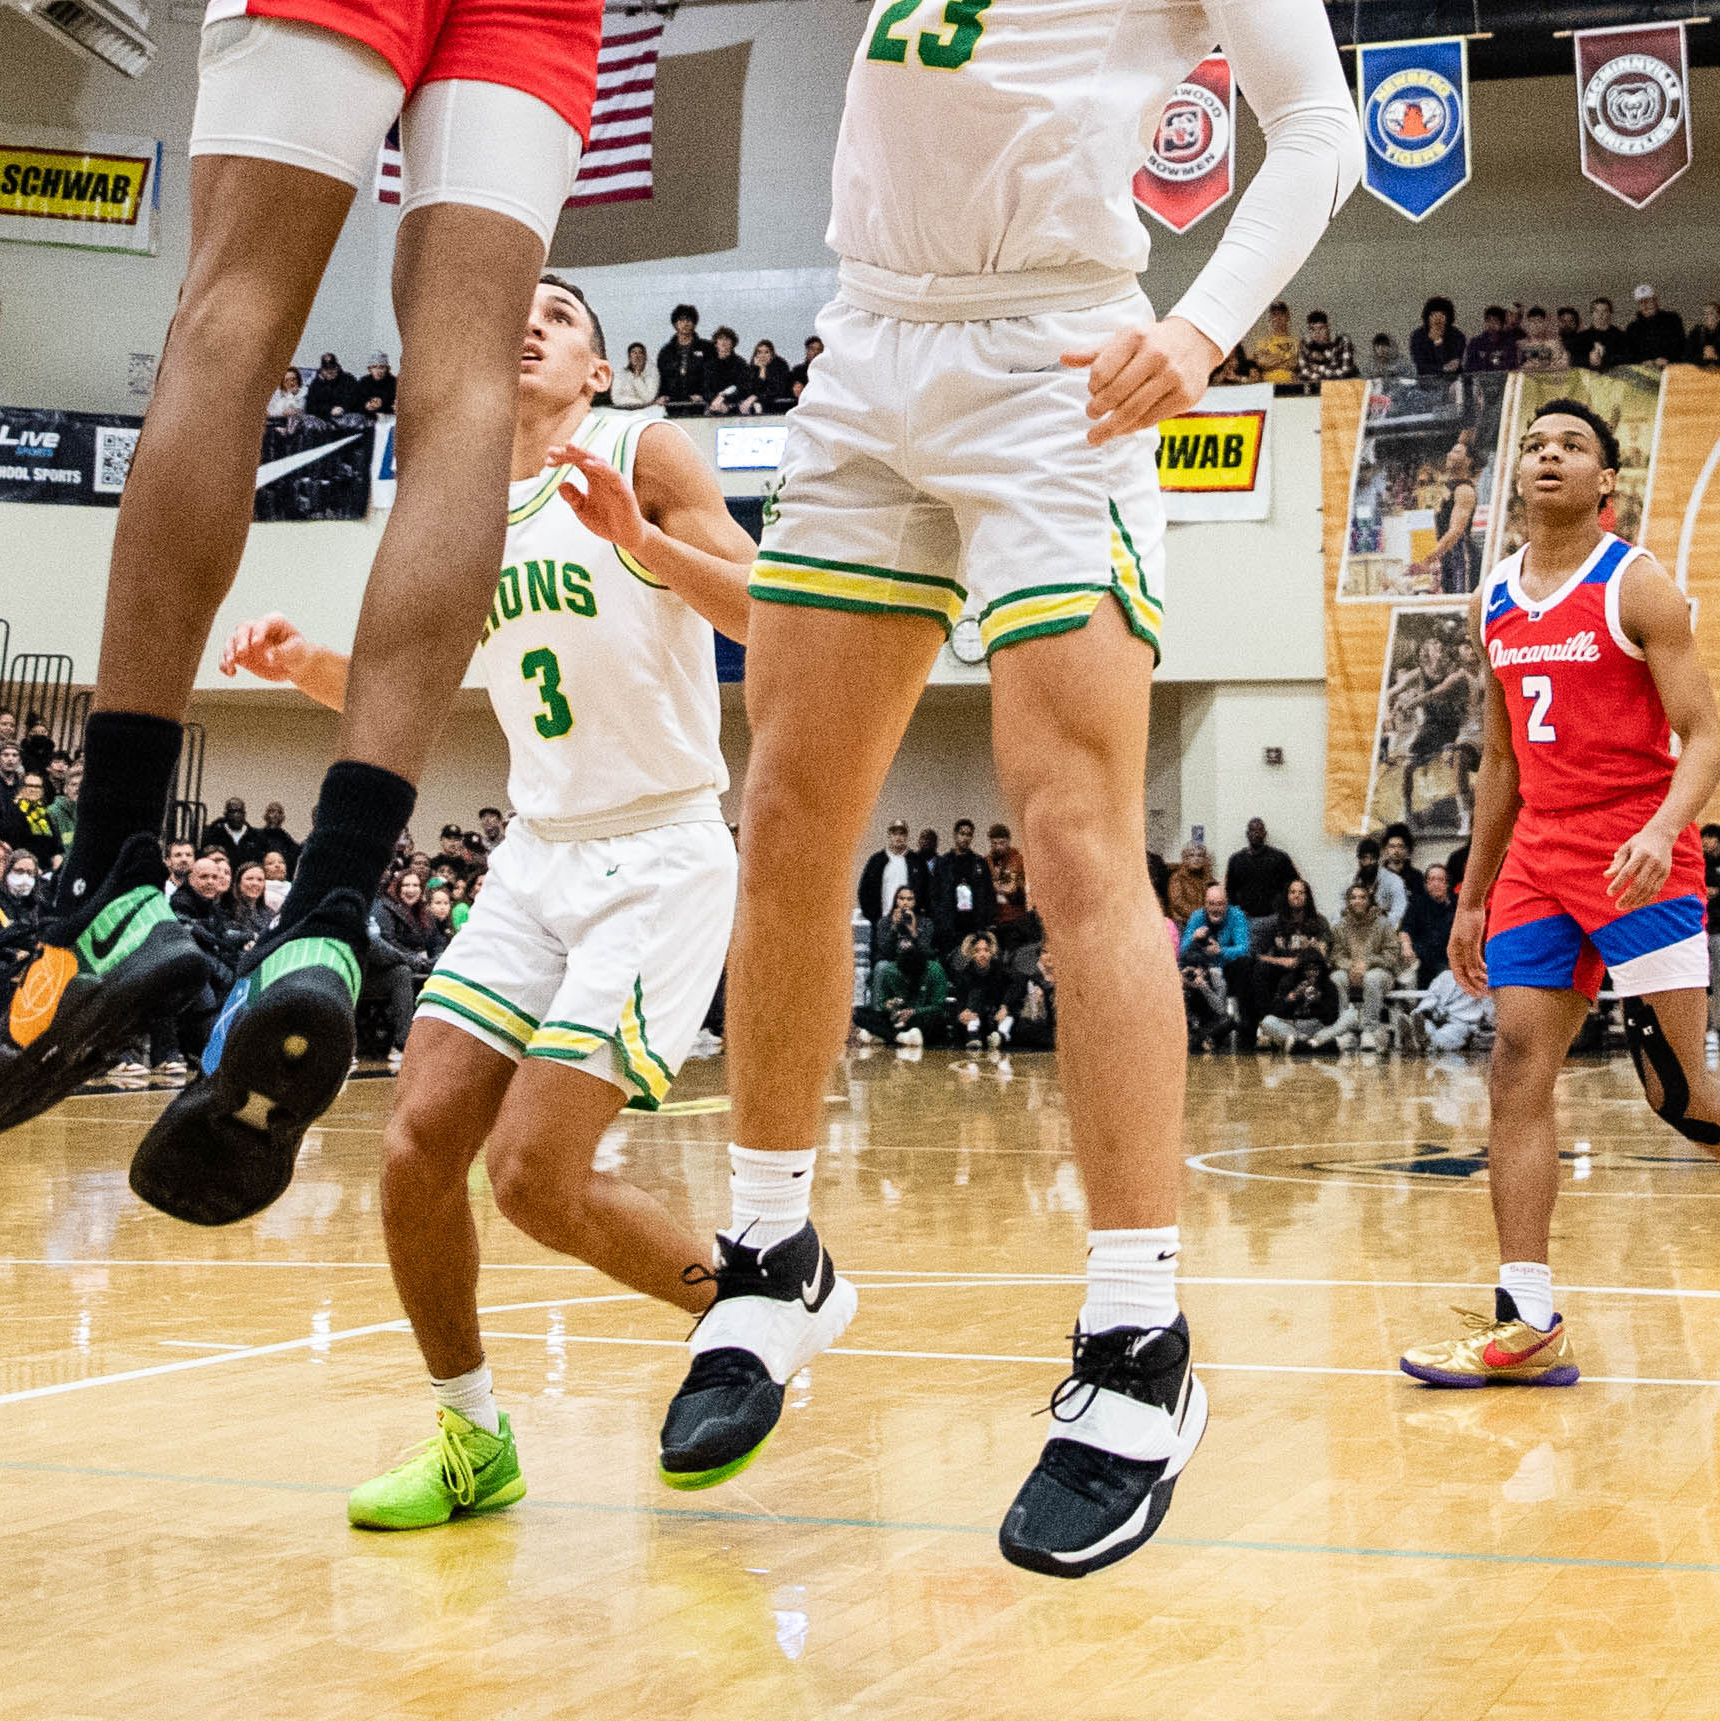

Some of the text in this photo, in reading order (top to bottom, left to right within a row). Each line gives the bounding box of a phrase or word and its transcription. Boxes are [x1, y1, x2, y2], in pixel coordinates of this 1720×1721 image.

[6, 165, 131, 204] SCHWAB
[33, 467, 82, 484] SPORTS
[1488, 631, 1601, 664] Duncanville
[521, 647, 575, 740] 3
[1522, 675, 1556, 743] 2
